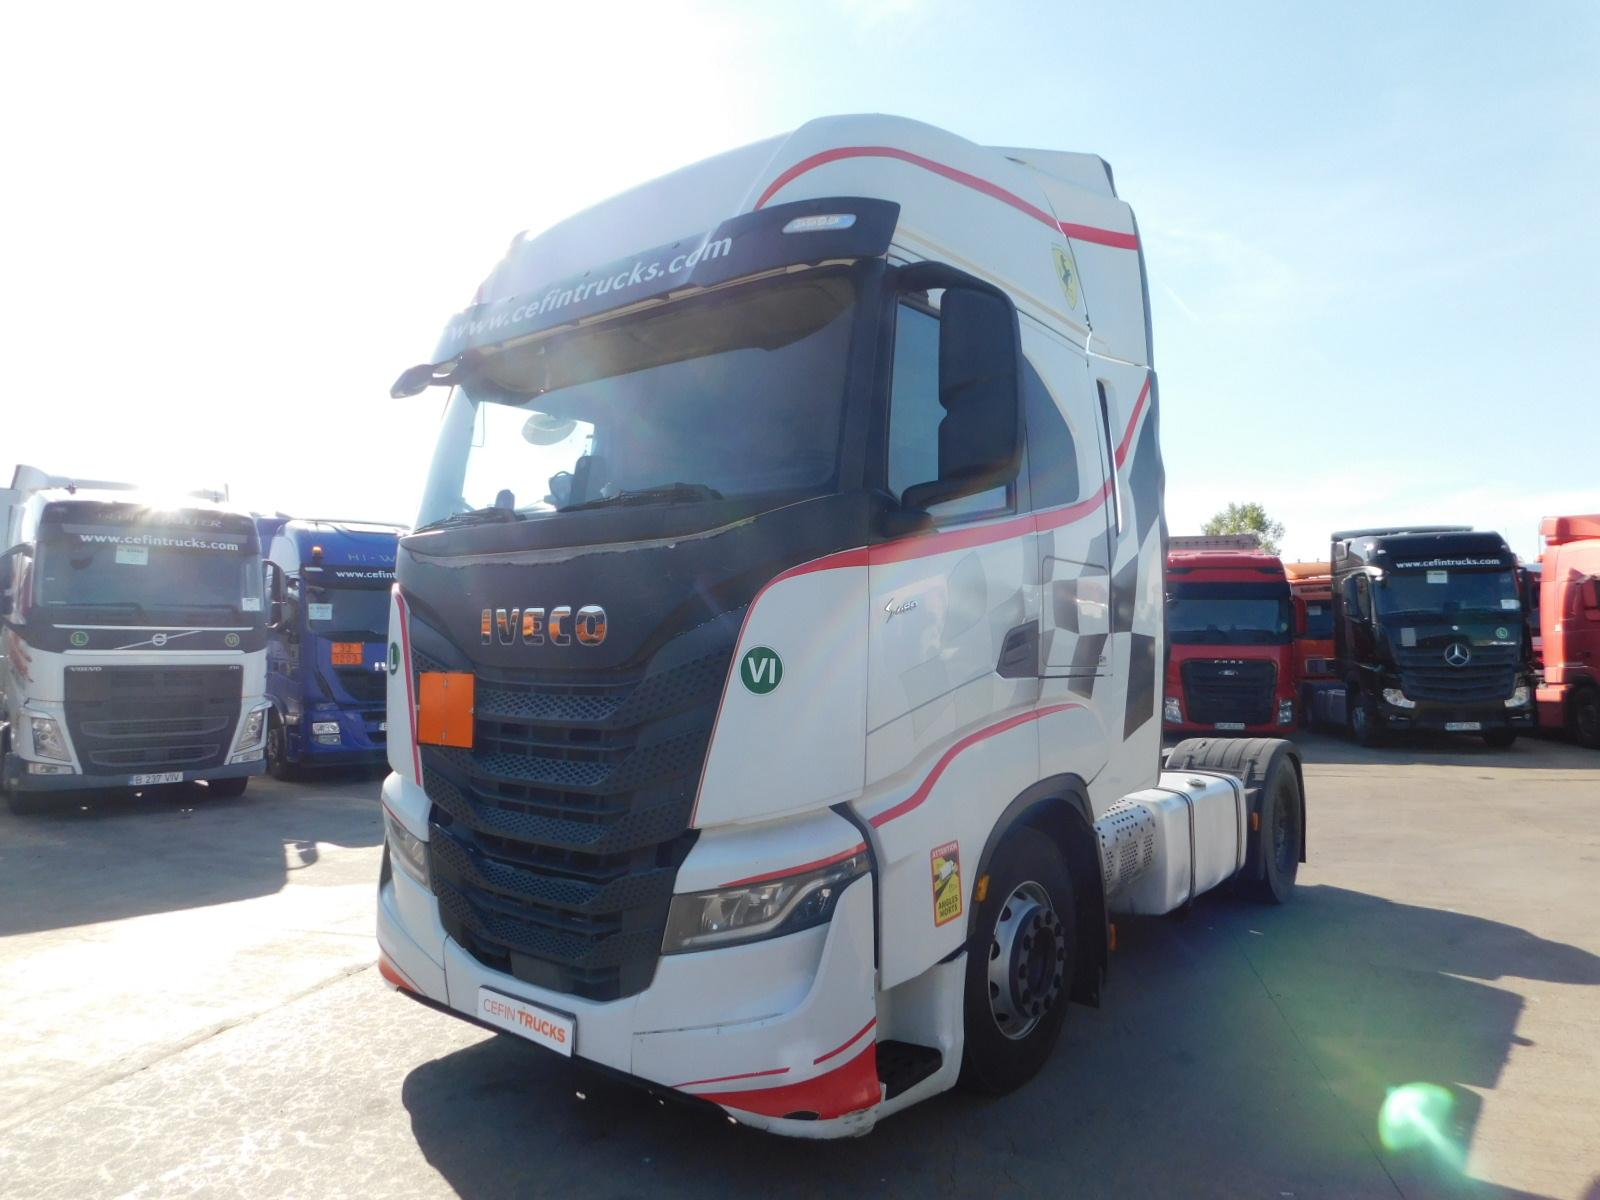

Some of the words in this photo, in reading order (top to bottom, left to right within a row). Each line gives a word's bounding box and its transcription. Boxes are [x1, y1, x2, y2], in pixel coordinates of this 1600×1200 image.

[447, 236, 733, 341] www.cefintrucks.com
[79, 534, 240, 552] www.cefintrucks.com
[1396, 557, 1500, 569] www.cefintrucks.com
[481, 604, 608, 646] IVECO
[747, 656, 776, 684] VI
[483, 998, 516, 1021] CEFIN
[517, 1010, 567, 1043] TRUCKS
